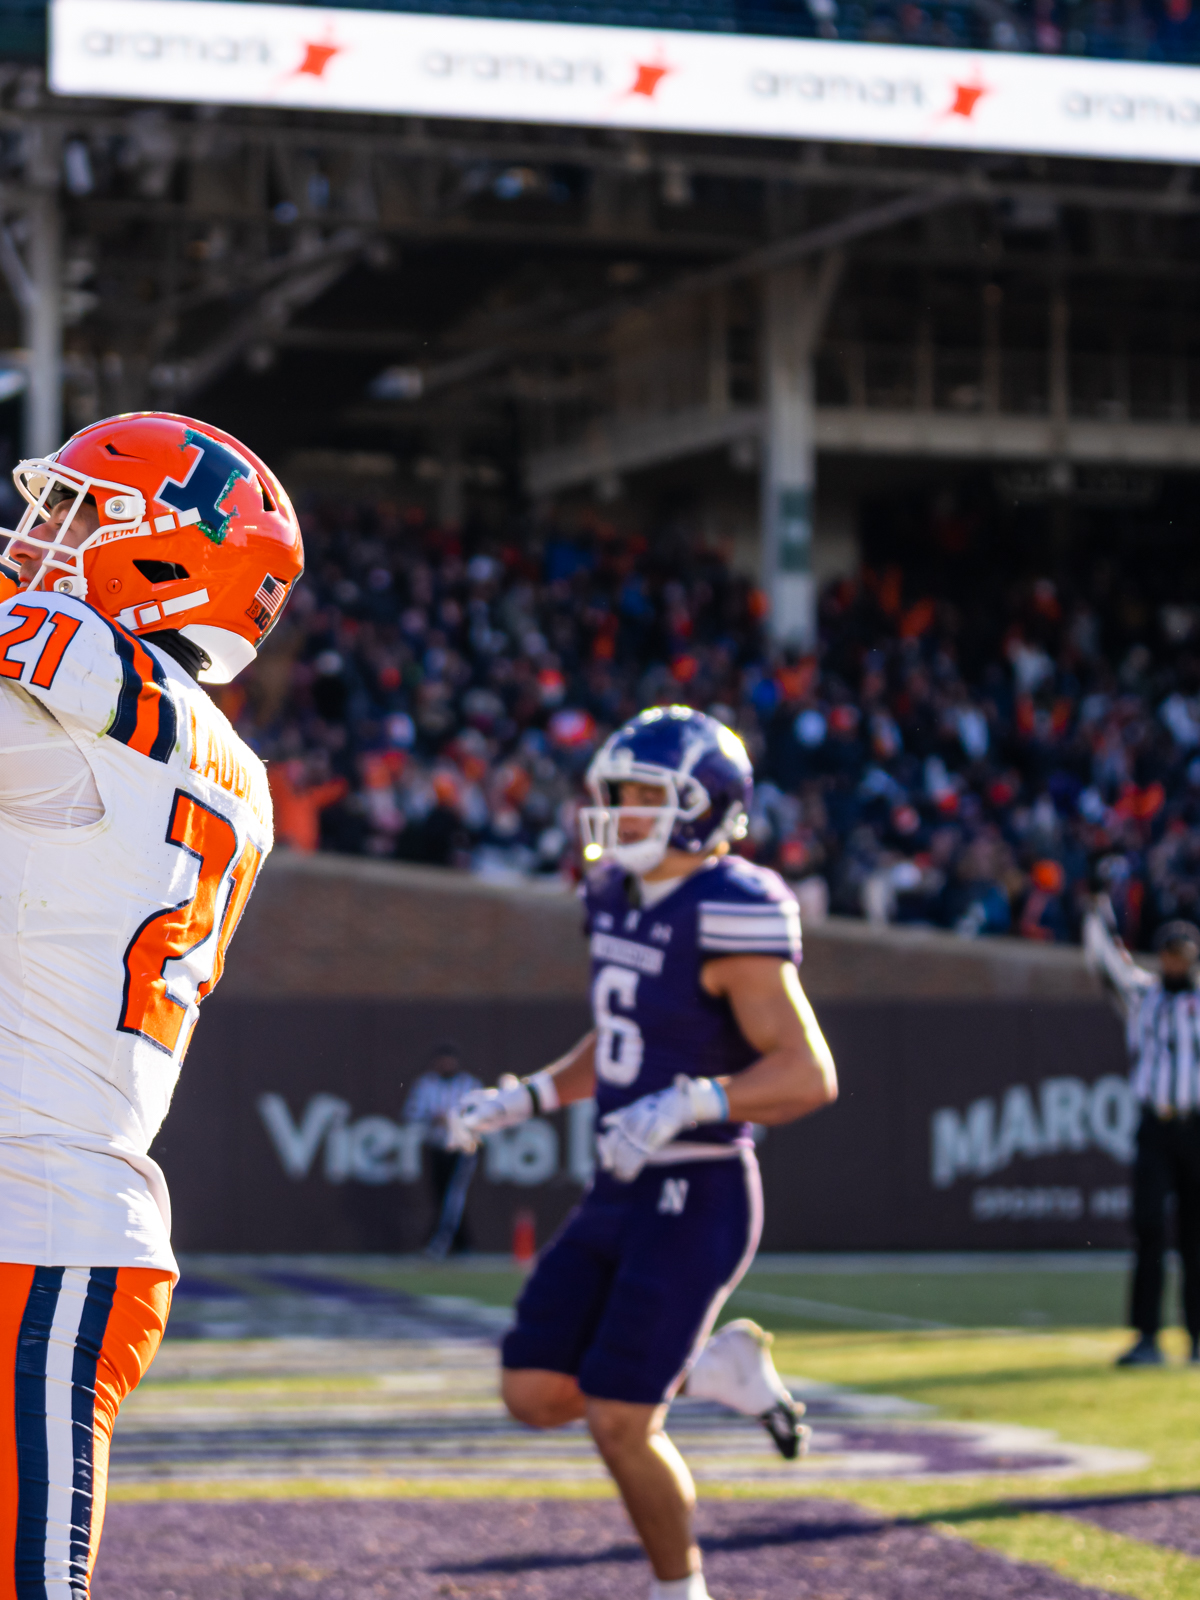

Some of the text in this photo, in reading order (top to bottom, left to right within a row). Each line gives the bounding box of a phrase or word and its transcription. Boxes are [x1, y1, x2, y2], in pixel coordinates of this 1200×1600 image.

[83, 26, 273, 66] aramark
[422, 46, 606, 87] aramark
[750, 66, 927, 107] aramark
[592, 964, 644, 1087] 6
[658, 1177, 690, 1215] N
